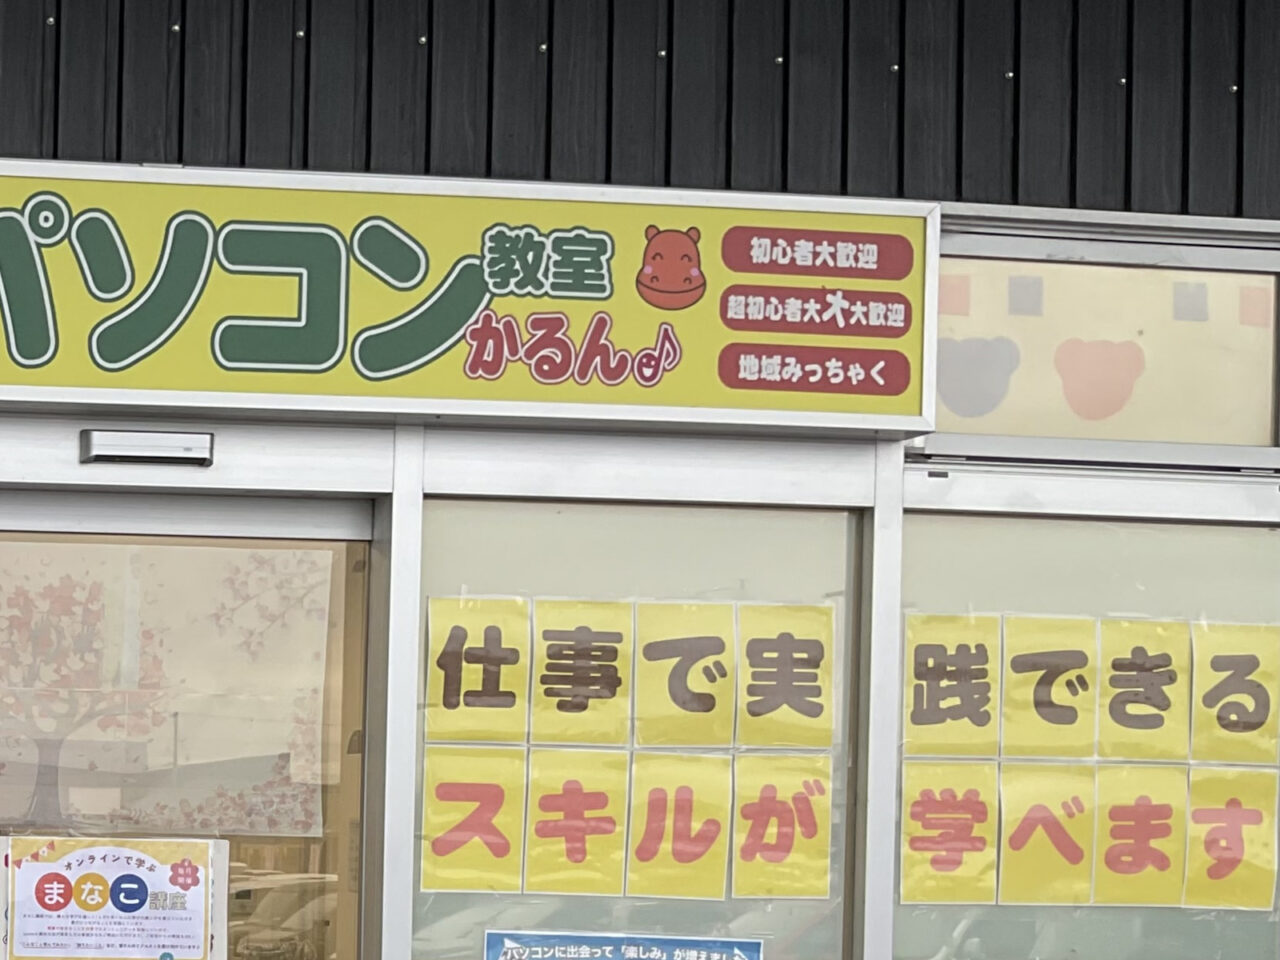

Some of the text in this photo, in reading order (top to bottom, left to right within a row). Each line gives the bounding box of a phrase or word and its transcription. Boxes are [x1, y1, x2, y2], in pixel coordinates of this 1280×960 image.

[482, 225, 613, 302] 教室
[749, 236, 878, 270] 初心者大歓迎
[738, 354, 885, 386] 地域みっちゃく
[436, 625, 1271, 733] 仕事で実 践できる
[431, 779, 1263, 880] スキルが 学べます
[64, 854, 157, 872] オンラインで学ぶ
